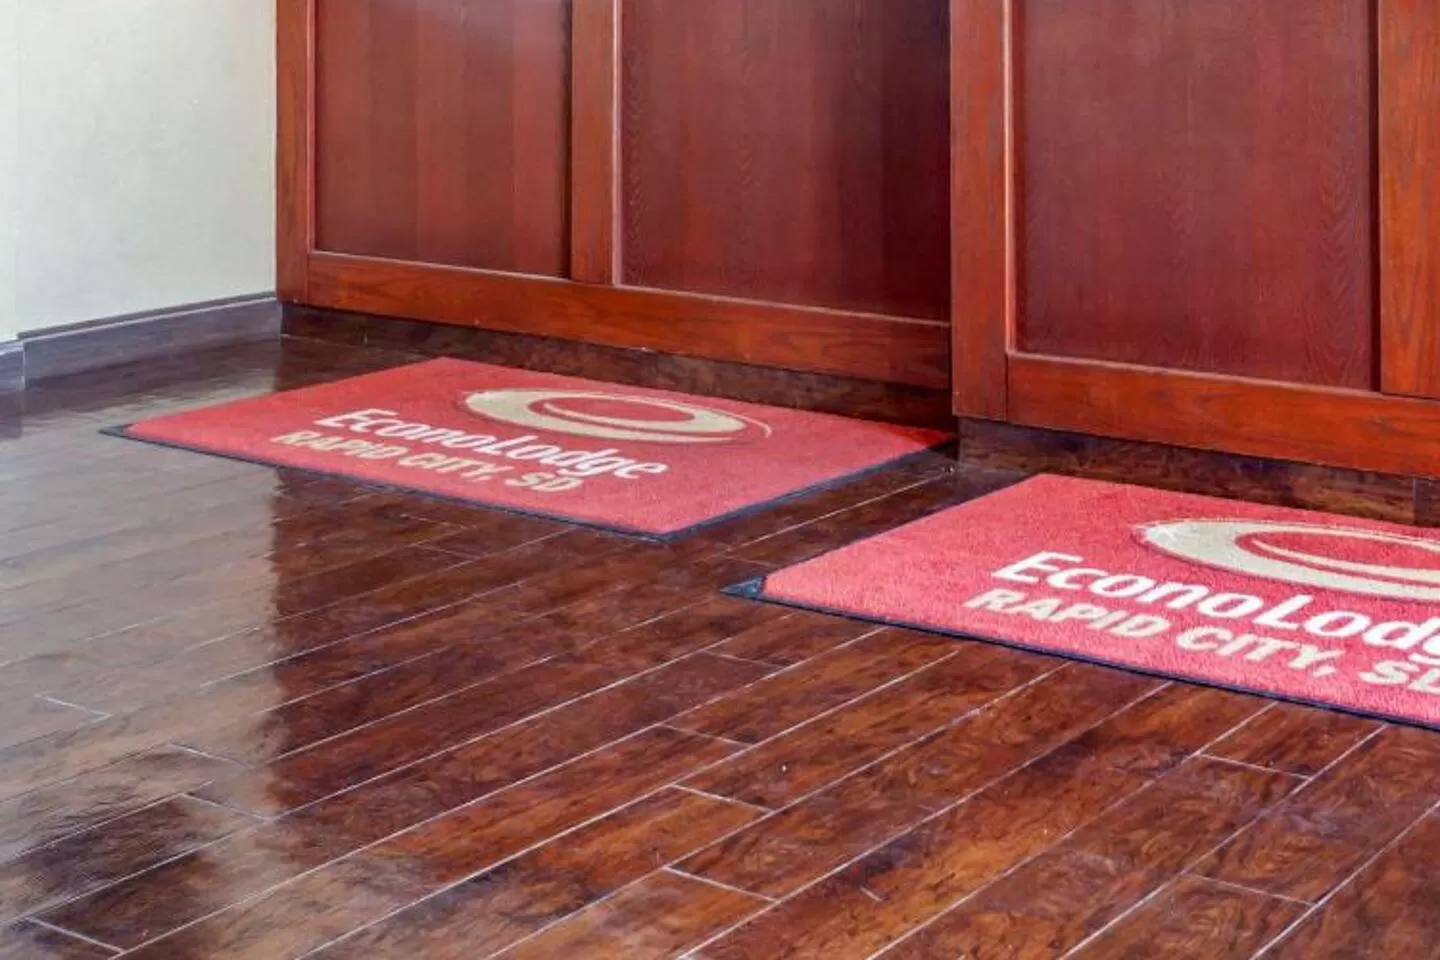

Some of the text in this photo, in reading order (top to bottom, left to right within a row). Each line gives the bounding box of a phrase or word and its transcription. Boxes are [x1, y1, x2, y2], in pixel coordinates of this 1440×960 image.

[269, 429, 585, 492] RAPID CITY, SD
[313, 408, 669, 479] EconoLodge
[963, 588, 1172, 638] RAPID
[1175, 623, 1345, 676] CITY,
